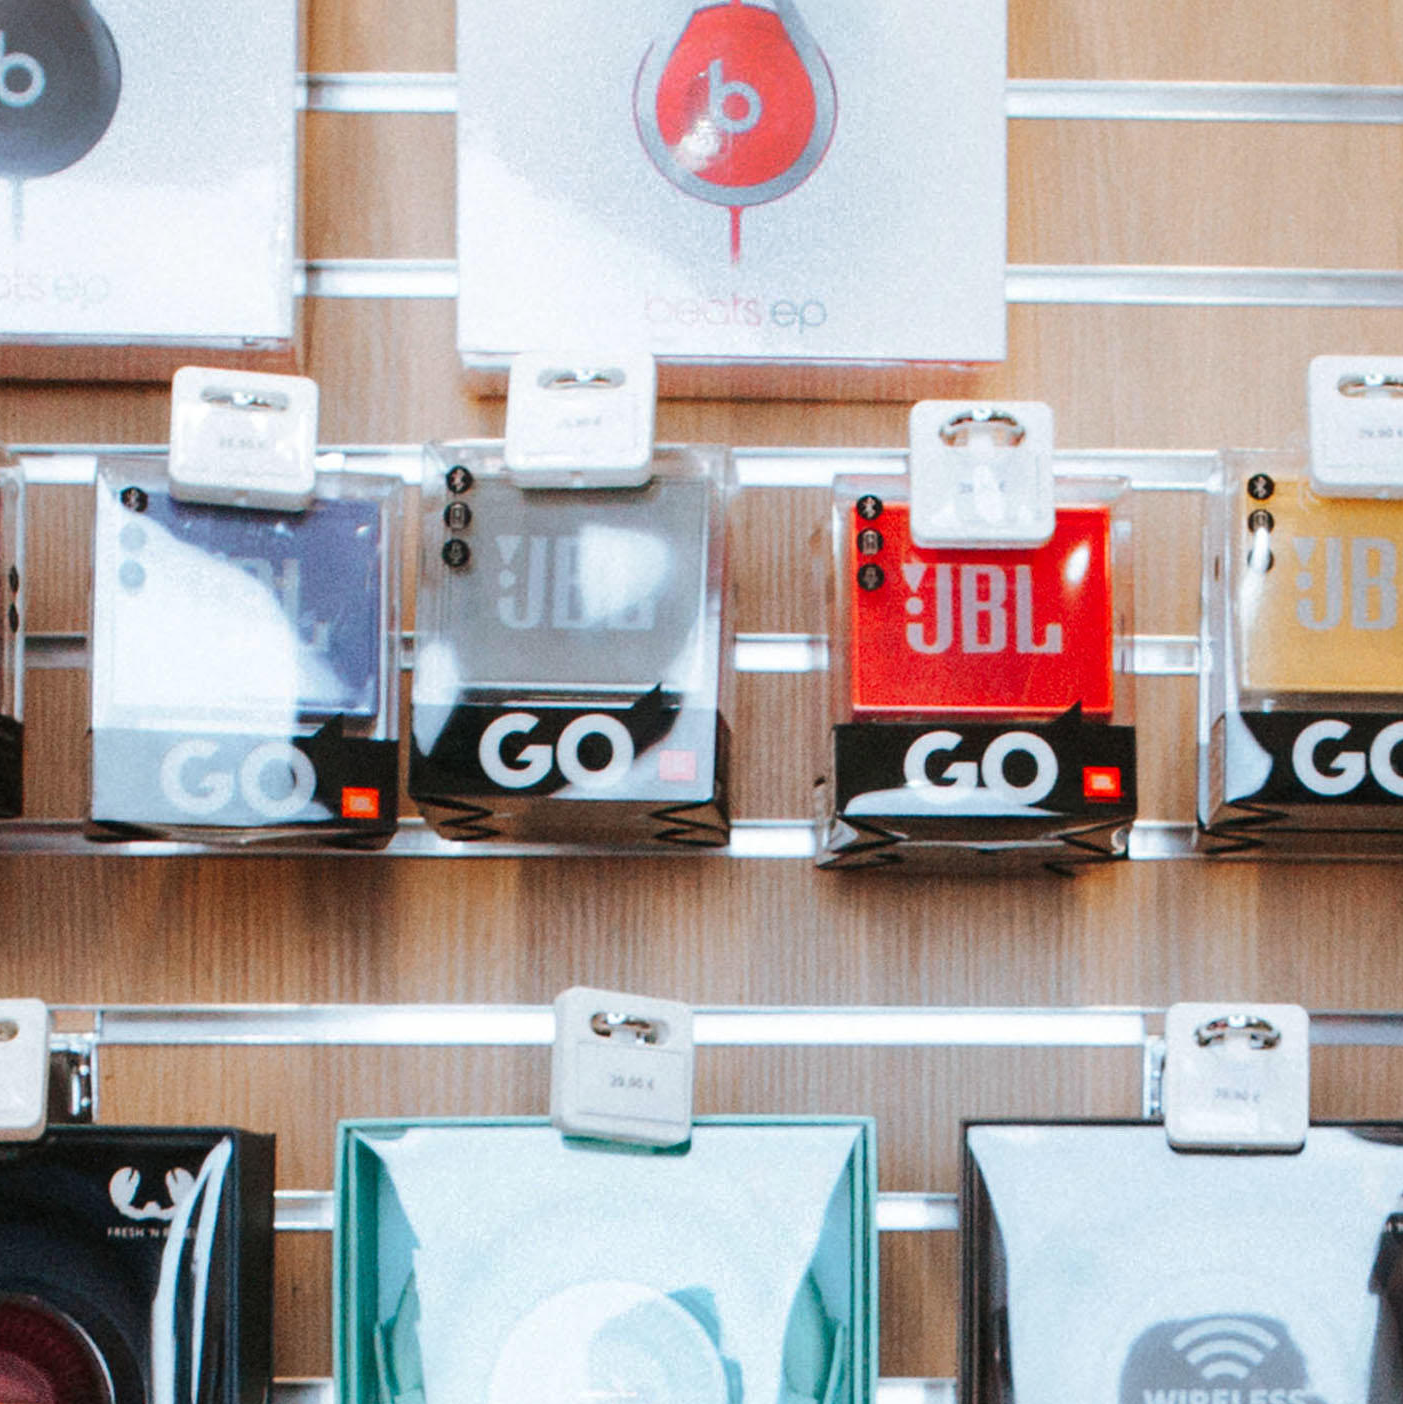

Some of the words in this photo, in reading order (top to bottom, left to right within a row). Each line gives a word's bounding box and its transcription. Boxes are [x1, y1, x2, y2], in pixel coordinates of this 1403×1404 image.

[770, 298, 828, 335] ep
[902, 563, 1064, 655] JBL
[160, 738, 317, 818] GO
[479, 711, 635, 789] GO
[903, 730, 1059, 808] GO
[107, 1226, 145, 1238] FRESH
